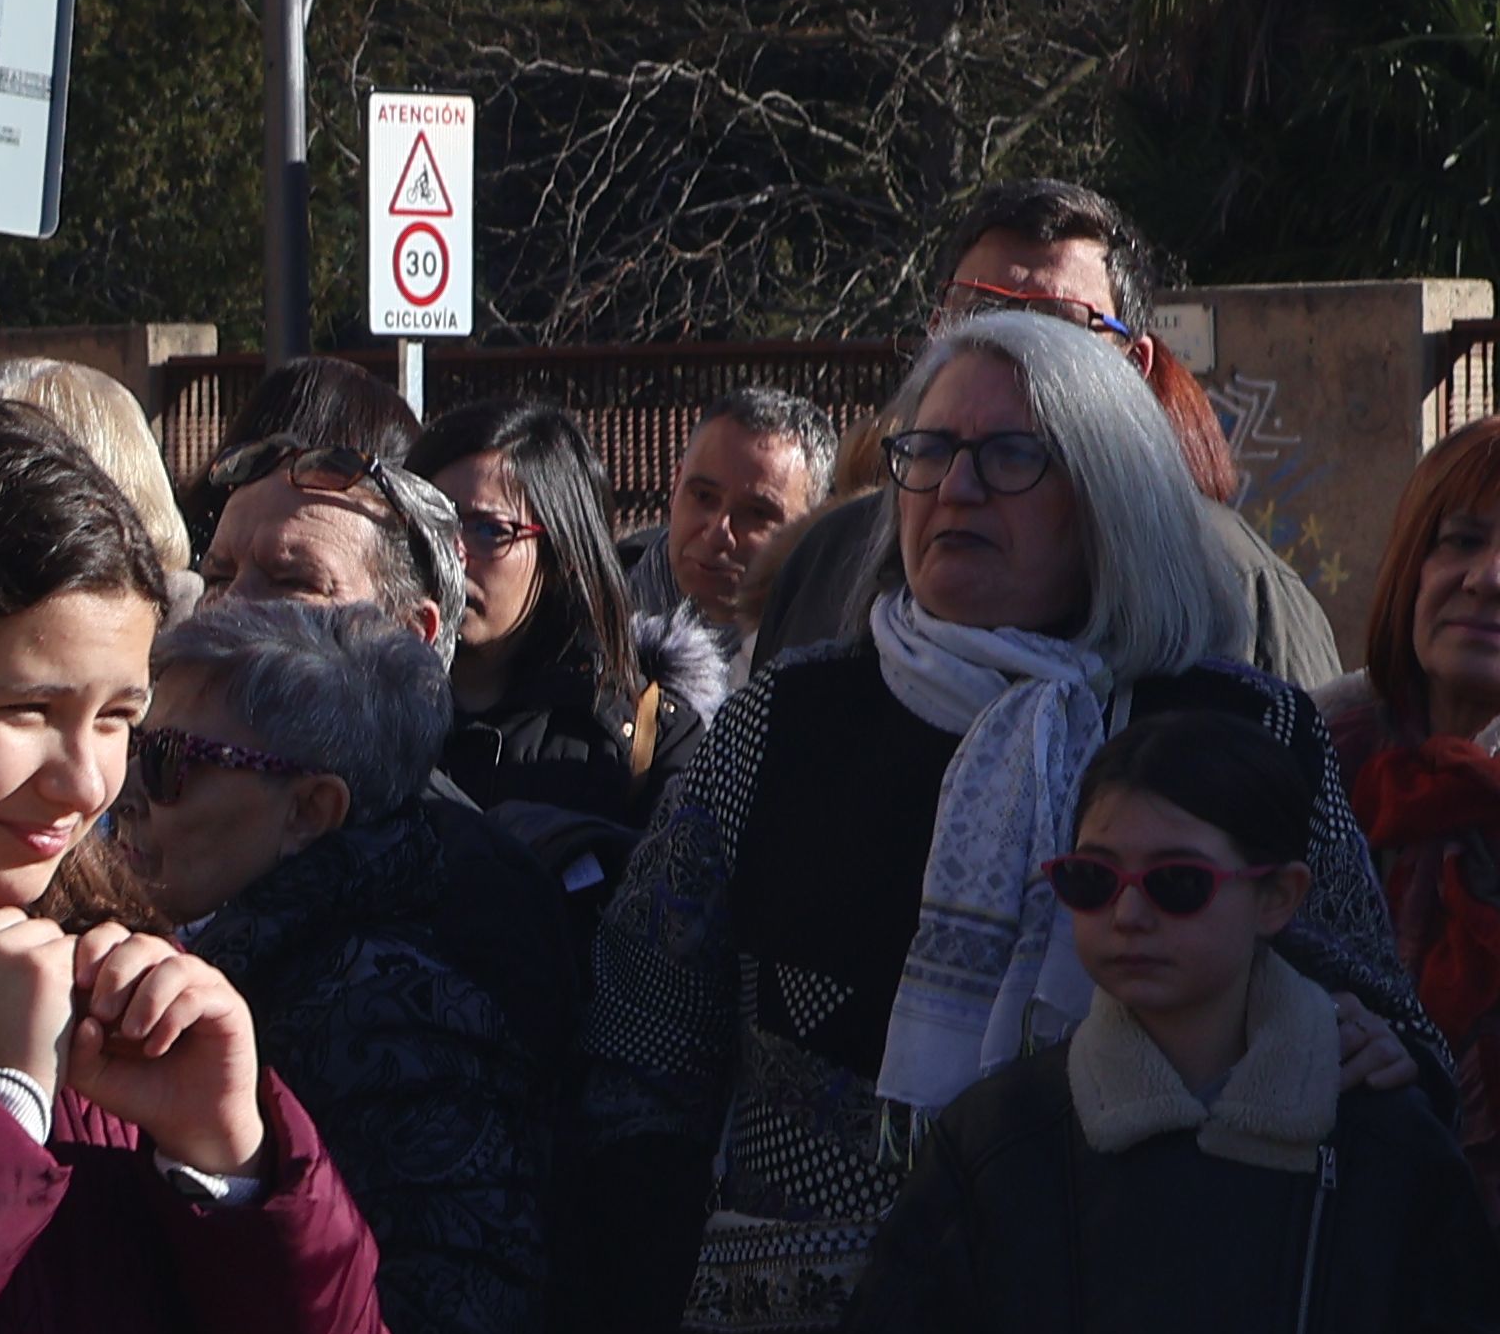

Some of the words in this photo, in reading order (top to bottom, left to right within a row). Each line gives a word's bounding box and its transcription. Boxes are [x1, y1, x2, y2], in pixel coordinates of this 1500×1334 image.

[378, 103, 466, 124] ATENCIÓN
[406, 251, 437, 277] 30
[384, 308, 458, 329] CICLOVÍA
